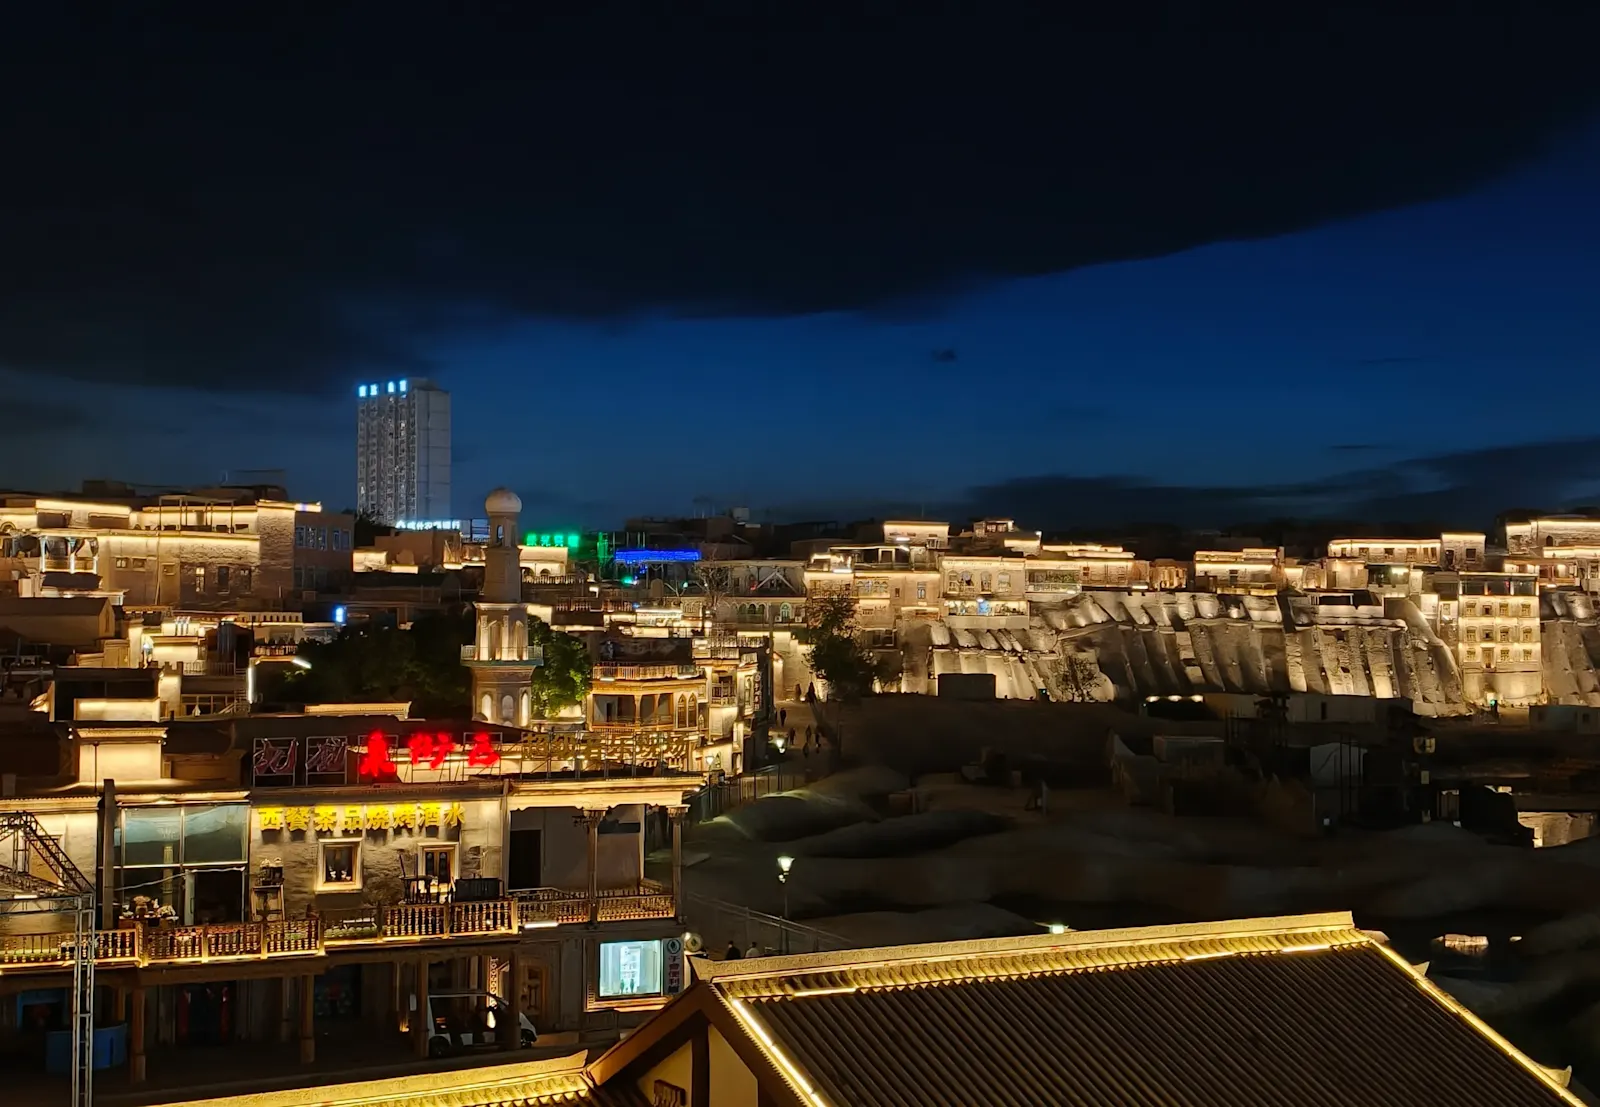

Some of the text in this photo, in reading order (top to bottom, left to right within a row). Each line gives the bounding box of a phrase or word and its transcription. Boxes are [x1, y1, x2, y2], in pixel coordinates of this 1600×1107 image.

[257, 801, 466, 831] 西餐茶品烧烤酒水
